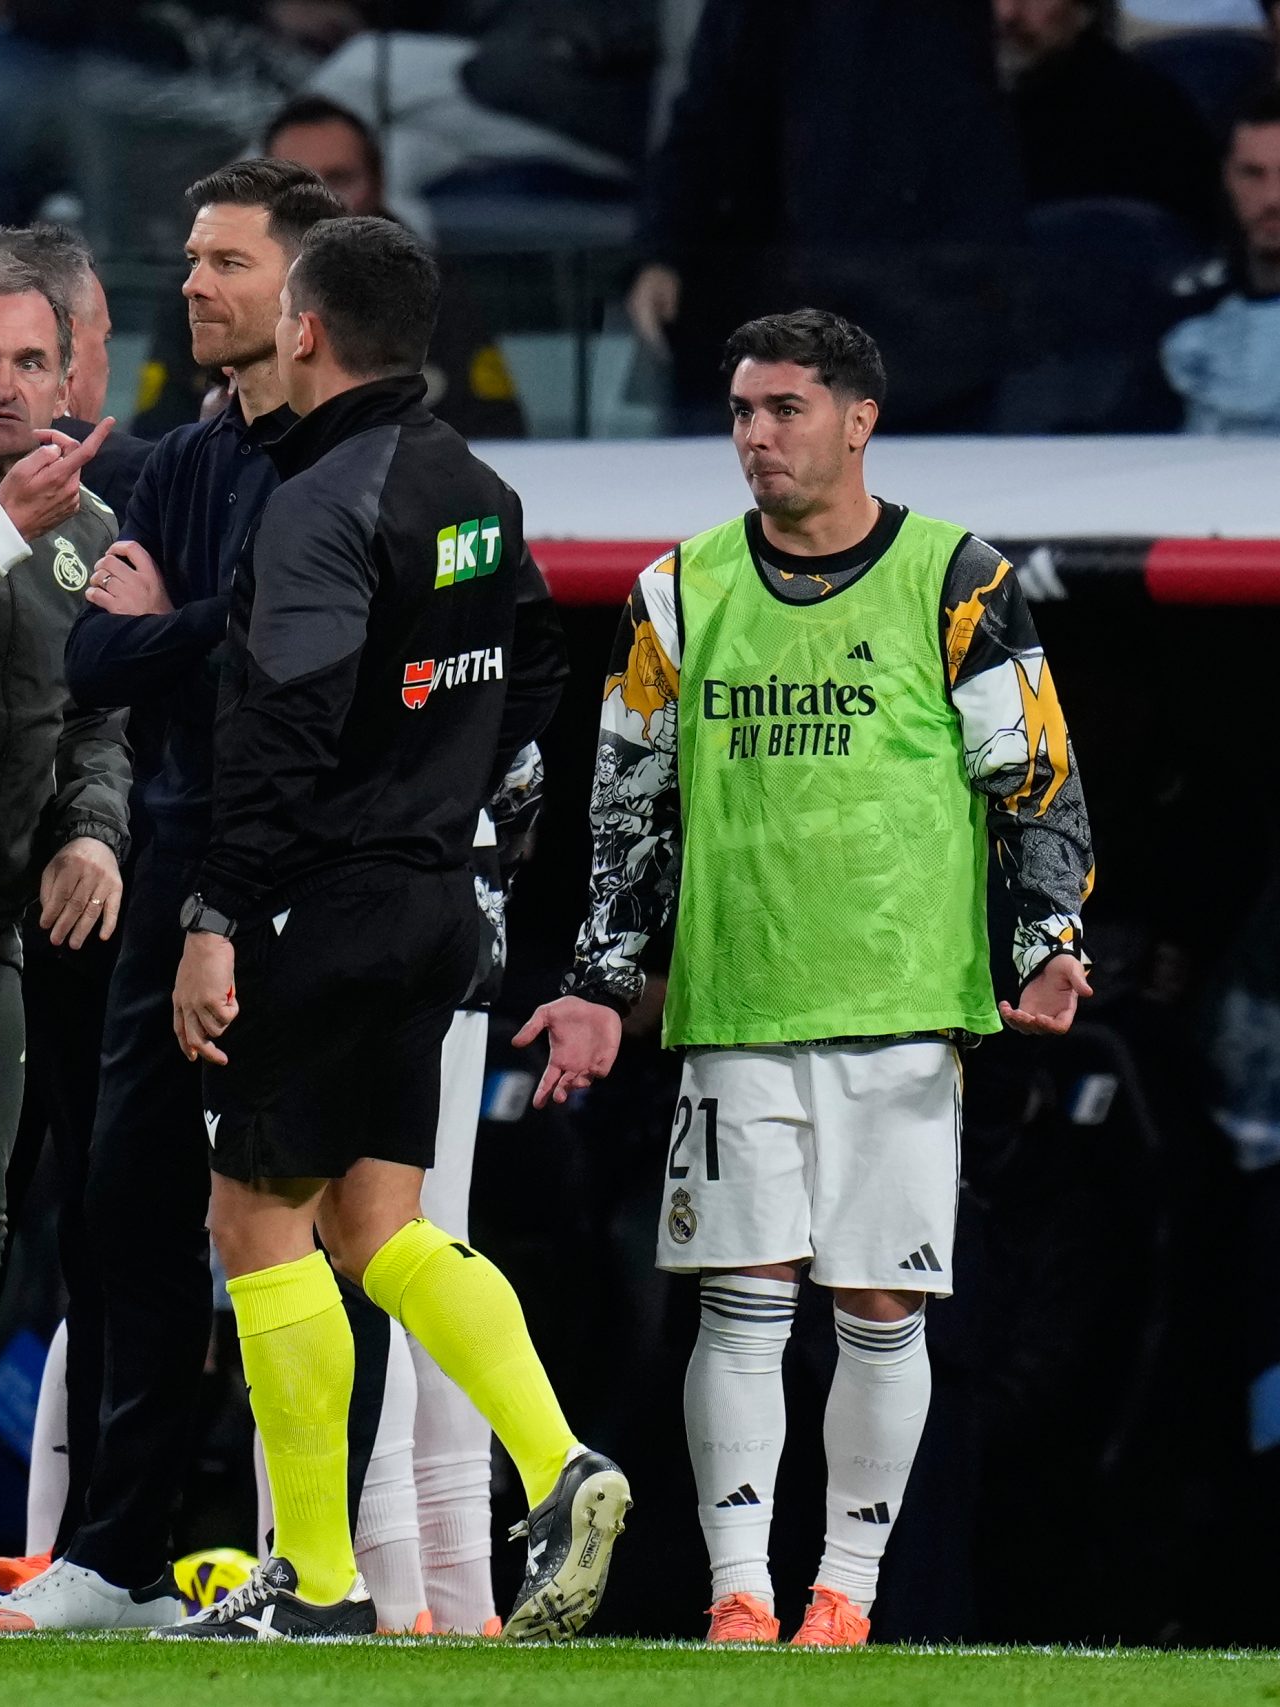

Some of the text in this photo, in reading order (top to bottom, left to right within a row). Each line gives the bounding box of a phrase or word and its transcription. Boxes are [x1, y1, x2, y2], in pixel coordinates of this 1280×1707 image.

[437, 526, 500, 577] BKT
[703, 674, 877, 720] Emirates
[729, 723, 851, 760] FLY BETTER
[669, 1095, 720, 1181] 21
[853, 1455, 911, 1473] RMC
